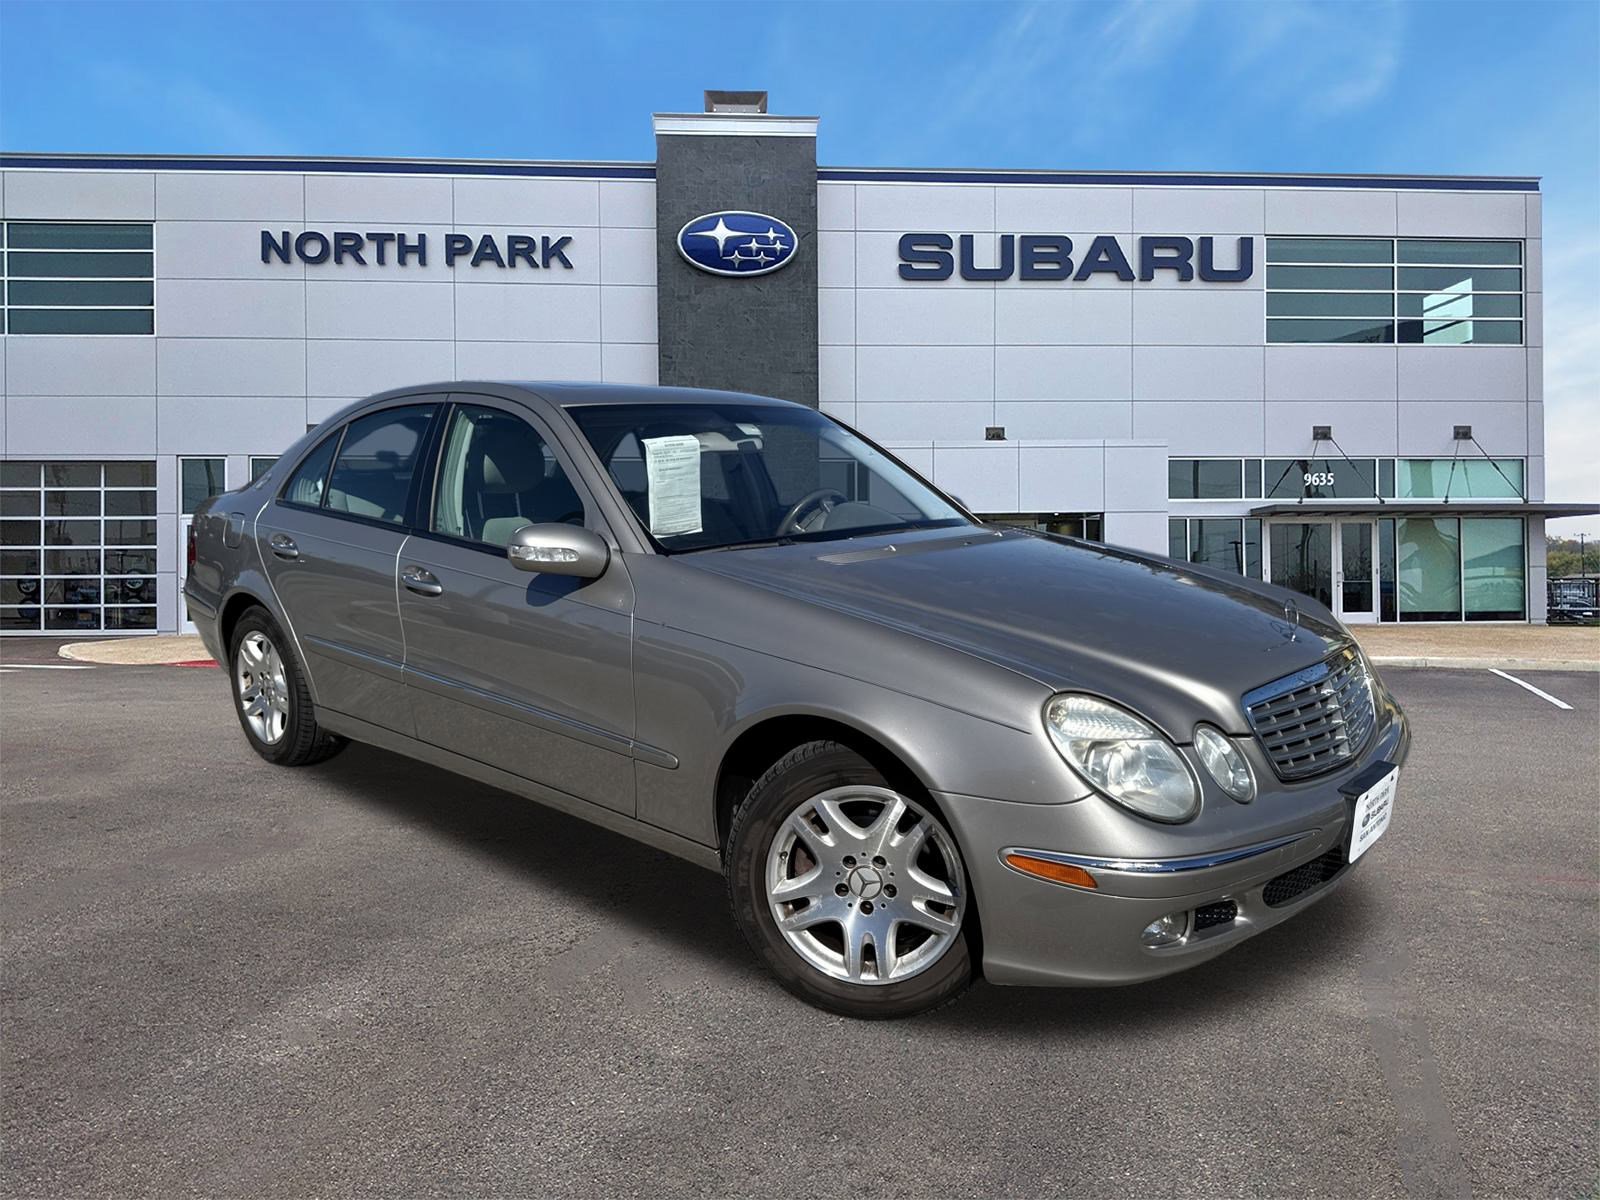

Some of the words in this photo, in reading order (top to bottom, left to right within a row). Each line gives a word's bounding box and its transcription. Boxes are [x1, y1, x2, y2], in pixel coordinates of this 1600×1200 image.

[260, 231, 427, 266] NORTH
[445, 233, 574, 268] PARK
[898, 232, 1254, 282] SUBARU
[1303, 472, 1335, 486] 9635
